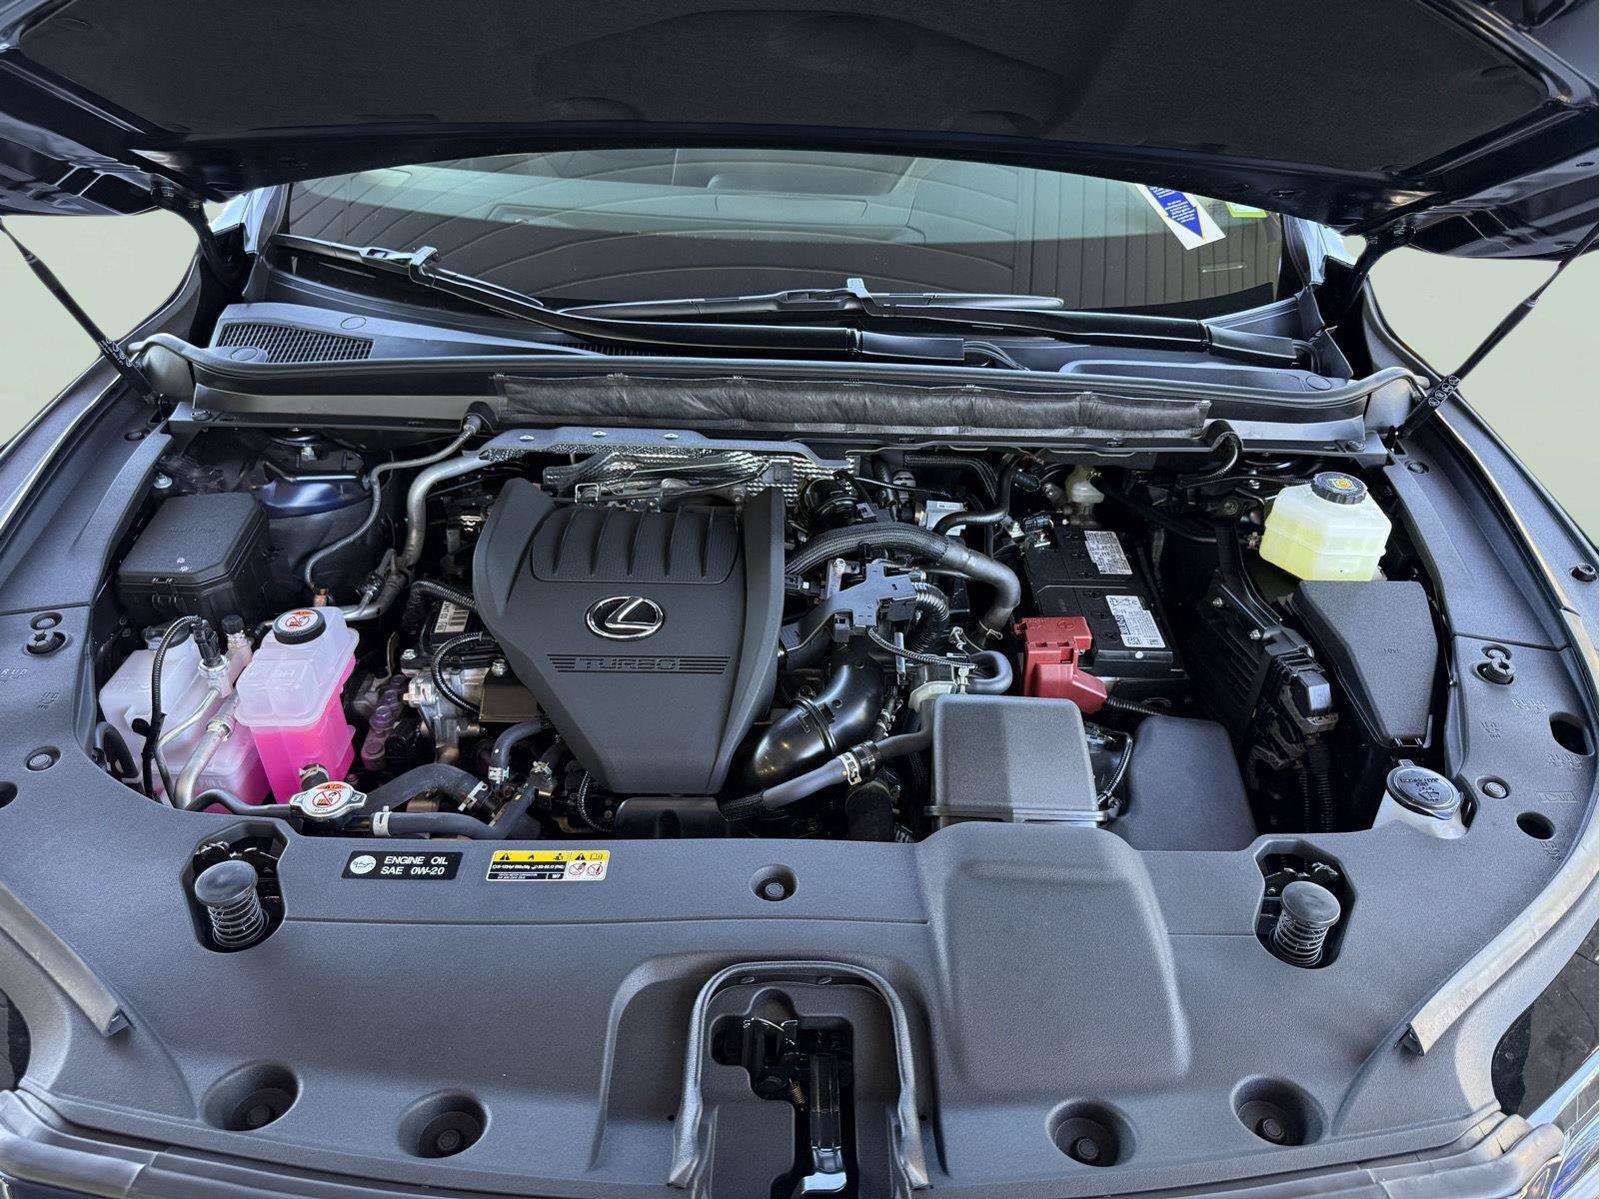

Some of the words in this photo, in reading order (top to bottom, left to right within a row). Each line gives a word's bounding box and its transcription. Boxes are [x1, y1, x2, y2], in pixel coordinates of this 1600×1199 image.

[578, 657, 677, 671] TURBO
[384, 856, 425, 865] ENGINE
[430, 856, 449, 865] OIL
[380, 866, 405, 875] SAE
[410, 866, 445, 875] 0W-20
